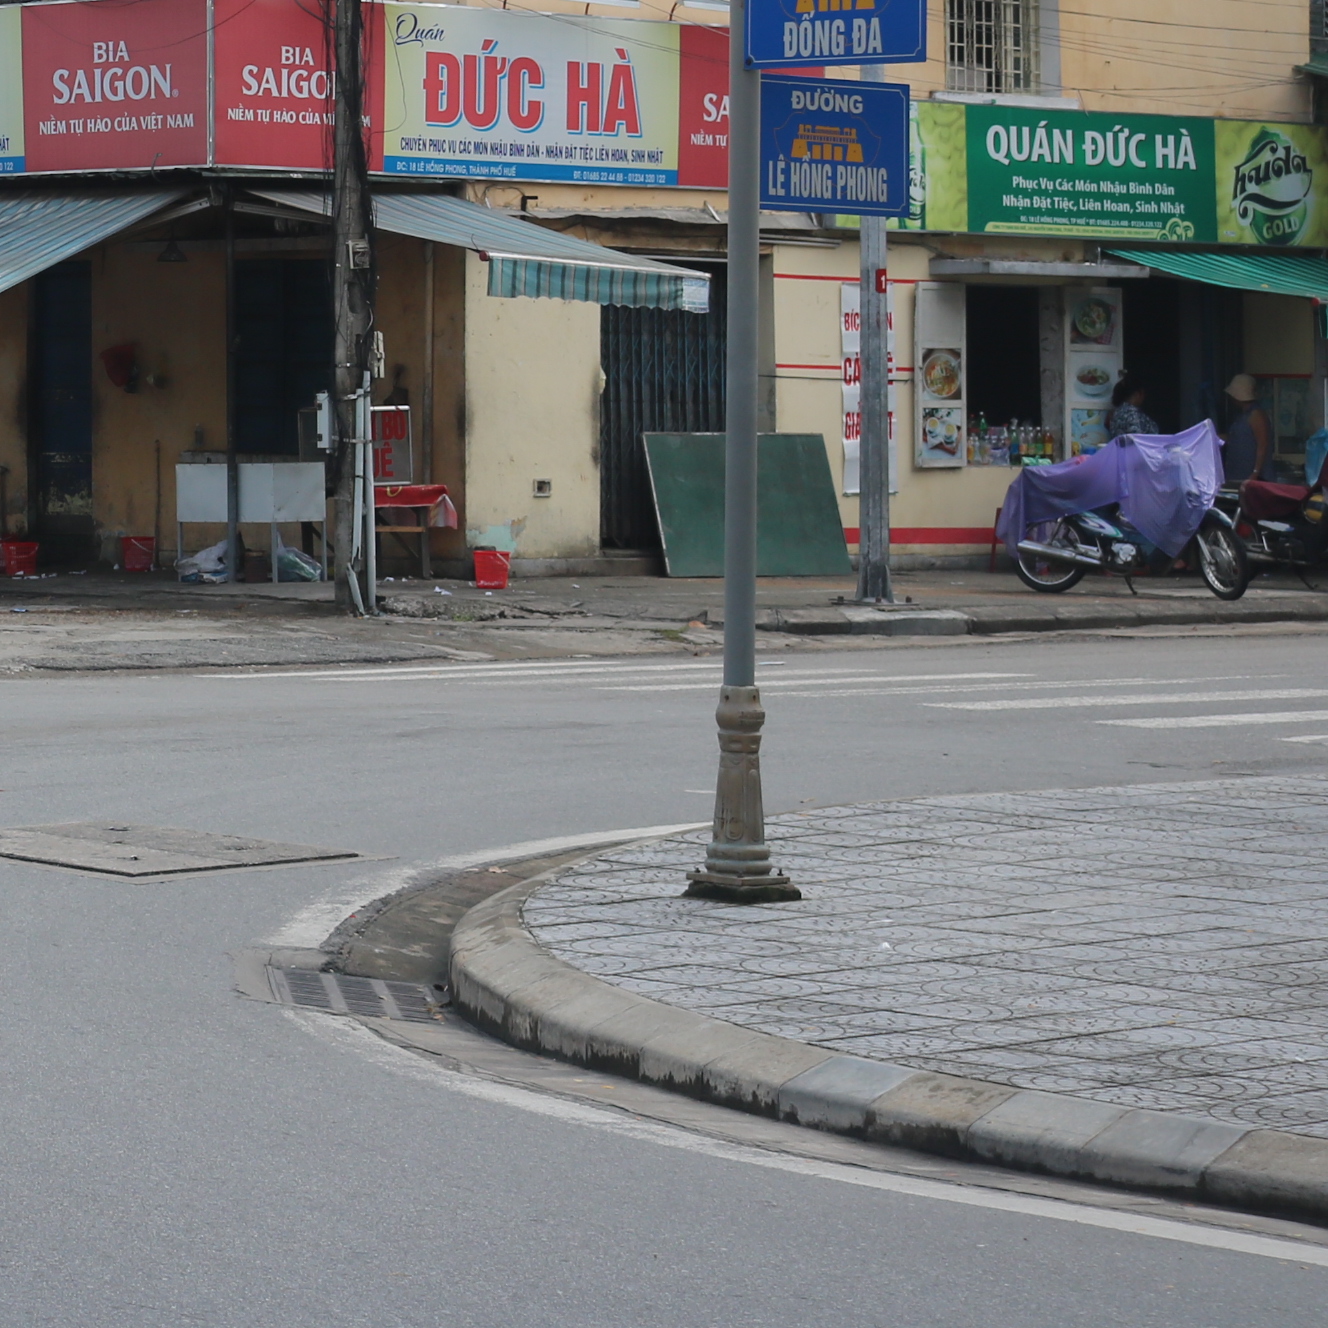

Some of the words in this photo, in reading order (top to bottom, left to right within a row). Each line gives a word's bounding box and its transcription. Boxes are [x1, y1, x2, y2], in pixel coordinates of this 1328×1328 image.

[394, 13, 445, 48] Quán
[783, 10, 844, 58] ĐỐNG
[852, 17, 882, 54] ĐA
[93, 41, 130, 63] BIA
[280, 46, 315, 65] BIA
[52, 64, 172, 104] SAIGON
[242, 64, 335, 100] SAIGO
[422, 39, 545, 132] ĐỨC
[566, 47, 643, 138] HÀ
[227, 103, 254, 121] NIỀM
[256, 109, 271, 124] TỰ
[273, 108, 296, 123] HÀO
[299, 108, 321, 125] CỦA
[791, 88, 863, 114] ĐƯỜNG
[39, 114, 66, 135] NIỀM
[69, 118, 84, 136] TỰ
[87, 115, 111, 132] HÀO
[114, 112, 138, 131] CỦA
[140, 112, 163, 133] VIỆT
[166, 113, 194, 128] NAM
[400, 135, 427, 151] CHUYÊN
[428, 138, 446, 155] PHỤC
[448, 140, 457, 156] VỤ
[458, 137, 472, 154] CÁC
[473, 138, 488, 154] MÓN
[490, 139, 508, 158] NHẬU
[509, 140, 525, 157] BÌNH
[526, 141, 540, 158] DÂN
[545, 142, 563, 161] NHẬN
[564, 143, 578, 163] ĐẶT
[579, 143, 594, 163] TIỆC
[595, 144, 610, 161] LIÊN
[611, 148, 630, 164] HOAN,
[631, 149, 645, 163] SINH
[647, 147, 664, 166] NHẬT
[690, 129, 713, 146] NIỀM
[715, 134, 728, 149] TỰ
[986, 120, 1074, 166] QUÁN
[1082, 125, 1146, 168] ĐỨC
[1155, 128, 1197, 170] HÀ
[768, 153, 785, 196] LÊ
[790, 152, 832, 200] HỒNG
[837, 165, 887, 202] PHONG
[1012, 176, 1038, 193] Phục
[1039, 177, 1054, 193] Vụ
[1055, 178, 1073, 191] Các
[1075, 178, 1098, 192] Món
[1100, 181, 1127, 196] Nhậu
[1129, 181, 1153, 195] Bình
[1154, 183, 1175, 196] Dân
[1002, 194, 1031, 210] Nhận
[1032, 196, 1052, 211] Đặt
[1053, 196, 1077, 212] Tiệc,
[1079, 199, 1101, 211] Liên
[1103, 200, 1133, 213] Hoan,
[1135, 201, 1158, 213] Sinh
[1160, 201, 1185, 217] Nhật
[1263, 216, 1299, 239] GOLD
